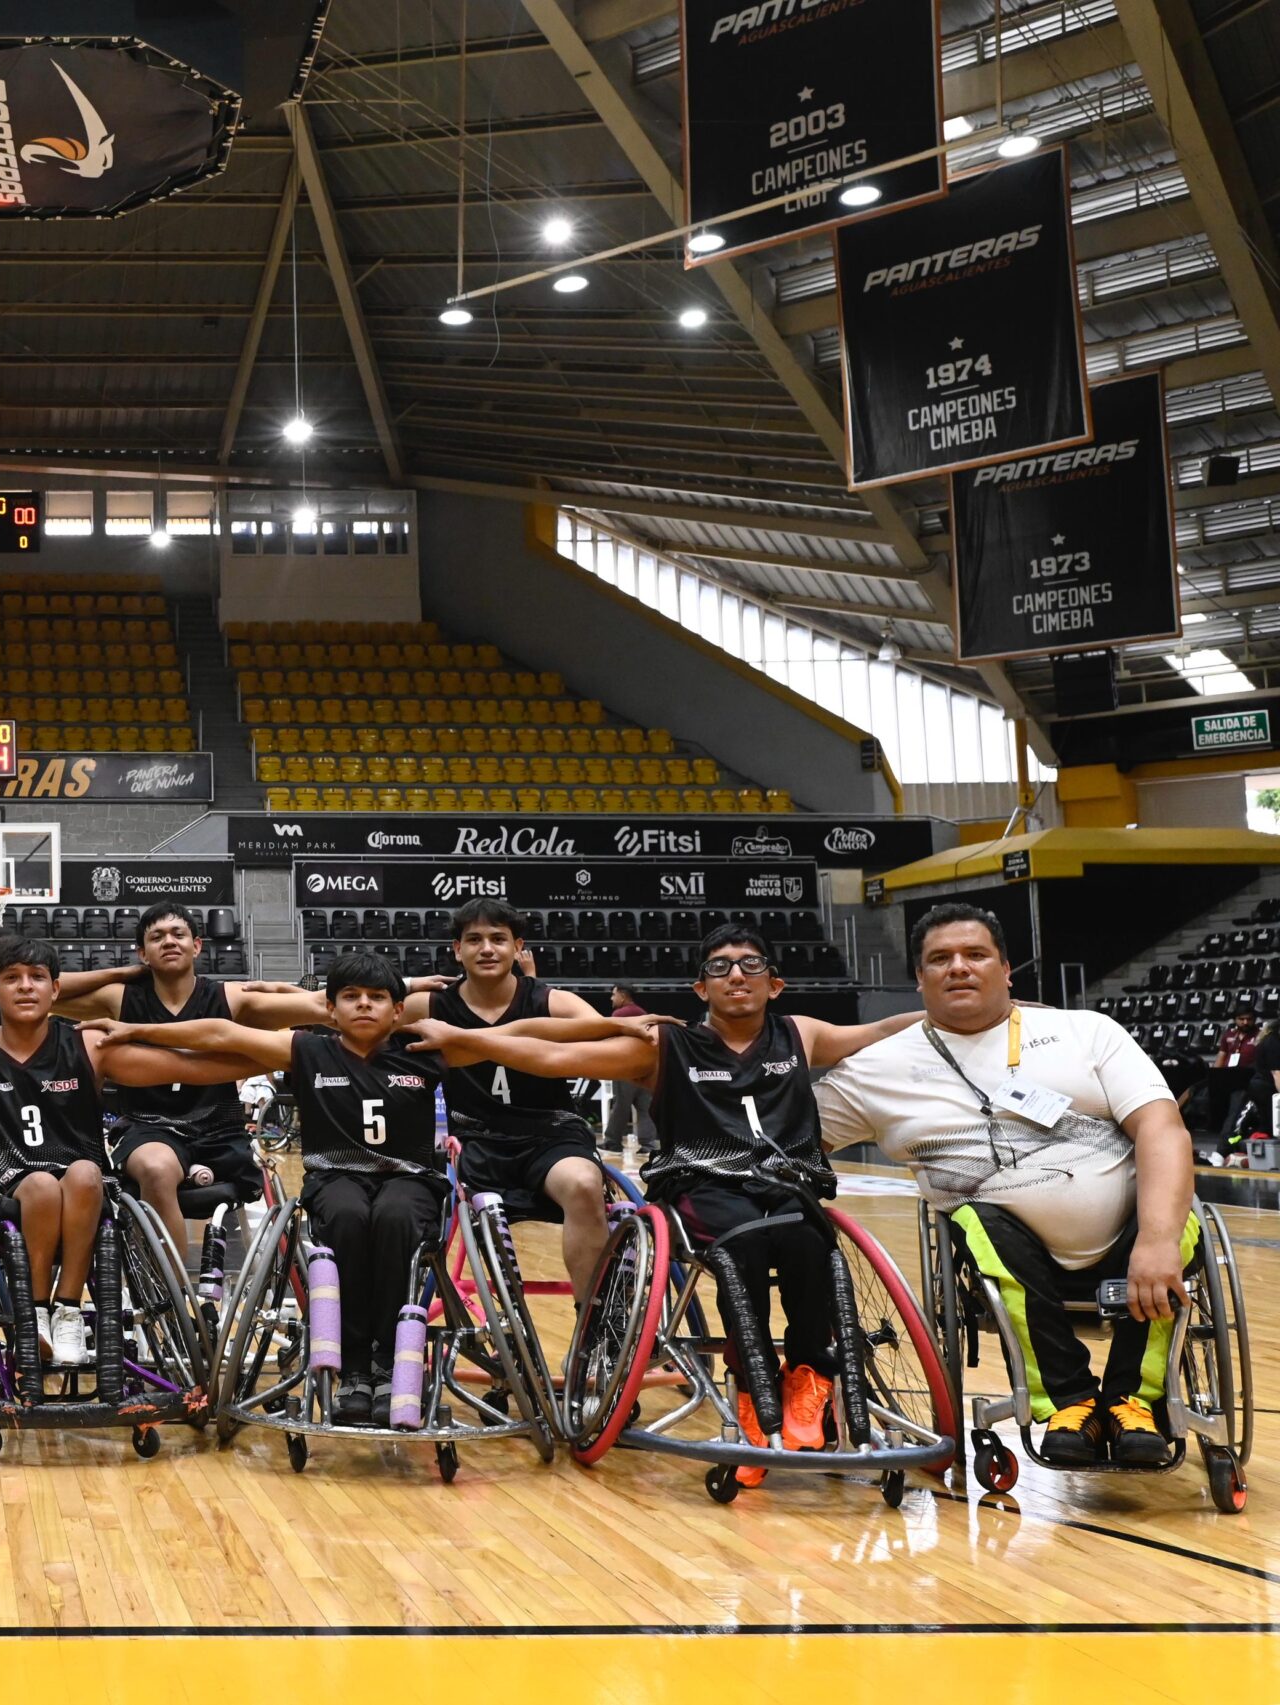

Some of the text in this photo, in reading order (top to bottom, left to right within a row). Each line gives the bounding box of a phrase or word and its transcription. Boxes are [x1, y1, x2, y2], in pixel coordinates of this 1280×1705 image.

[770, 103, 845, 148] 2003
[751, 139, 867, 195] CAMPEONES
[863, 225, 1043, 293] PANTERAS
[889, 257, 1013, 298] AGUASCALIENTES
[925, 354, 992, 389] 1974
[907, 387, 1016, 431] CAMPEONES
[929, 417, 997, 451] CIMEBA
[974, 439, 1139, 487] PANTERAS
[998, 465, 1111, 493] AGUASCALIENTES
[14, 507, 36, 525] 00
[19, 536, 28, 549] 0
[1030, 551, 1091, 579] 1973
[1013, 583, 1112, 615] CAMPEONES
[1032, 608, 1094, 634] CIMEBA
[1204, 716, 1256, 731] SALIDA DE
[1198, 729, 1265, 745] EMERGENCIA
[125, 764, 178, 782] PANTERA
[130, 772, 195, 793] QUE NUNCA
[238, 841, 299, 849] MERIDIAM
[367, 831, 422, 849] Corona
[642, 829, 701, 852] Fitsi
[832, 827, 867, 842] Pollos
[125, 876, 171, 884] GOBIERNO
[180, 876, 212, 884] ESTADO
[135, 885, 206, 893] AGUASCALIENTES
[456, 876, 506, 896] Fitsi
[660, 875, 705, 894] SMI
[749, 878, 781, 887] tierra
[746, 887, 781, 896] nueva
[52, 1077, 79, 1092] ISDE
[491, 1065, 511, 1104] 4
[697, 1070, 731, 1078] SINALOA
[21, 1105, 44, 1147] 3
[362, 1099, 386, 1145] 5
[741, 1095, 762, 1138] 1
